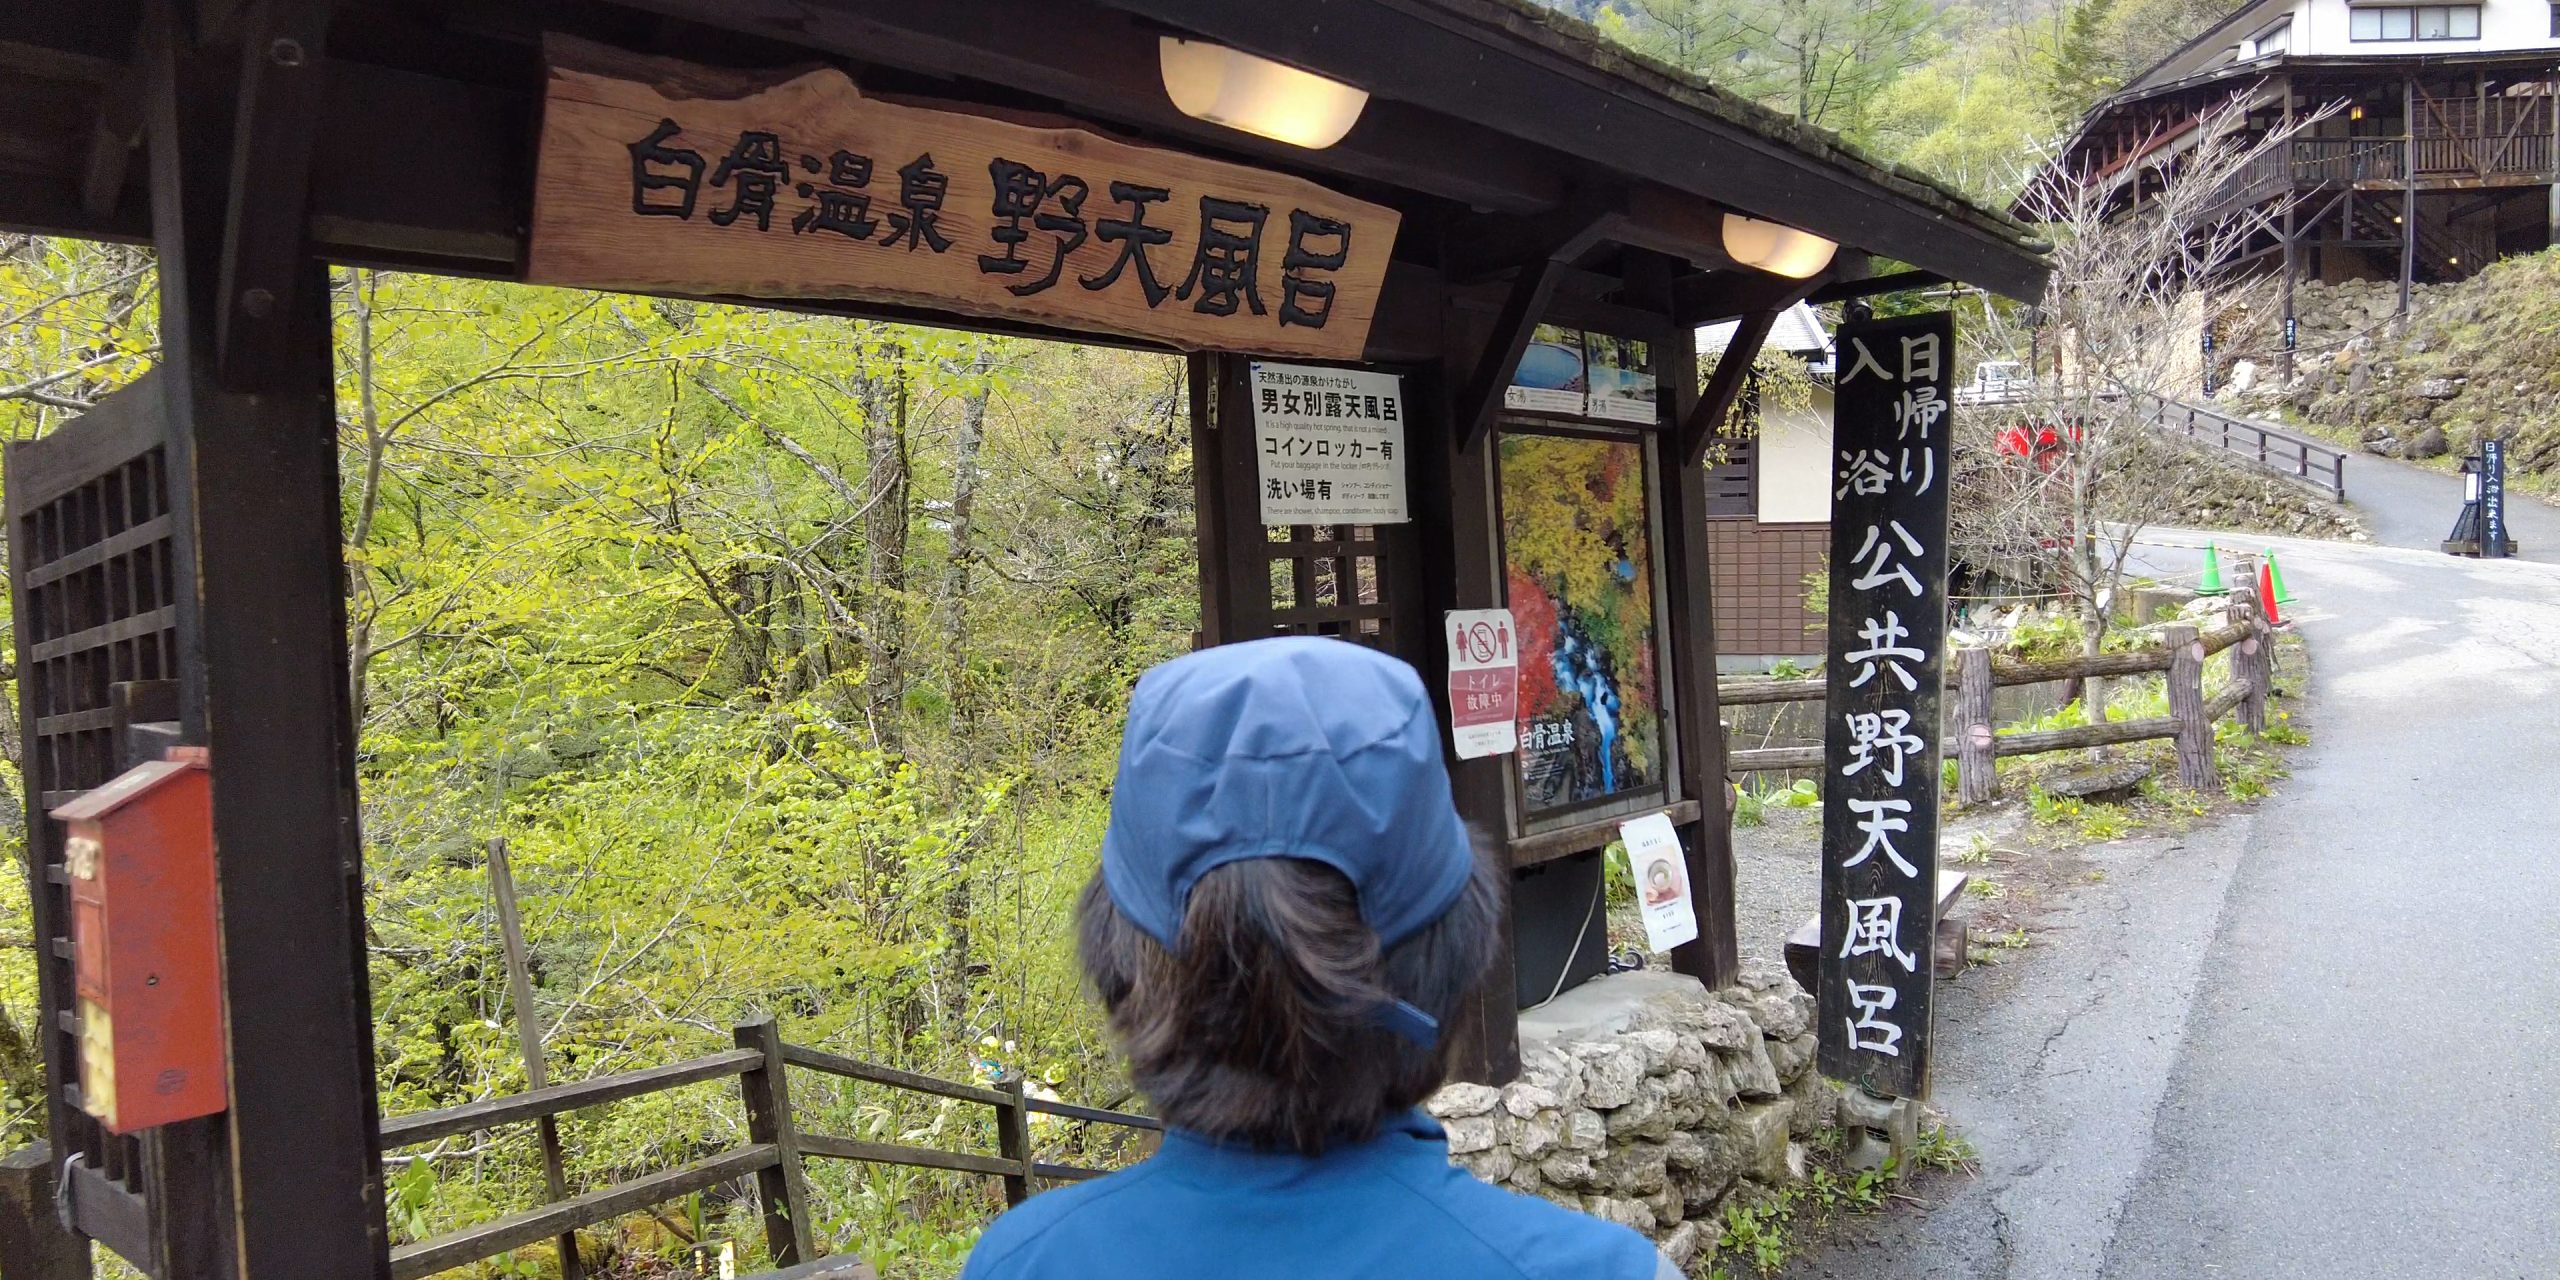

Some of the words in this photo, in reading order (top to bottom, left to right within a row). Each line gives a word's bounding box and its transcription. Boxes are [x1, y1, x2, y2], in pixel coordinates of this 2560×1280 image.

[627, 117, 953, 255] 白骨温泉
[977, 156, 1351, 328] 野天風呂
[1261, 388, 1398, 422] 男女別露天風呂
[1836, 336, 1894, 501] 入浴
[1894, 332, 1947, 497] 日帰り
[1280, 420, 1293, 431] high
[1294, 421, 1312, 432] quality
[1313, 422, 1323, 431] hot
[1264, 436, 1394, 461] コインロッカー有
[1270, 459, 1280, 469] Put
[1281, 461, 1294, 471] your
[1295, 460, 1321, 471] baggage
[1266, 477, 1332, 501] 洗い場有
[1468, 673, 1501, 691] トイレ
[1466, 691, 1502, 711] 故障中
[1519, 718, 1576, 750] 白骨温泉
[1839, 519, 1926, 1057] 公共野天風呂
